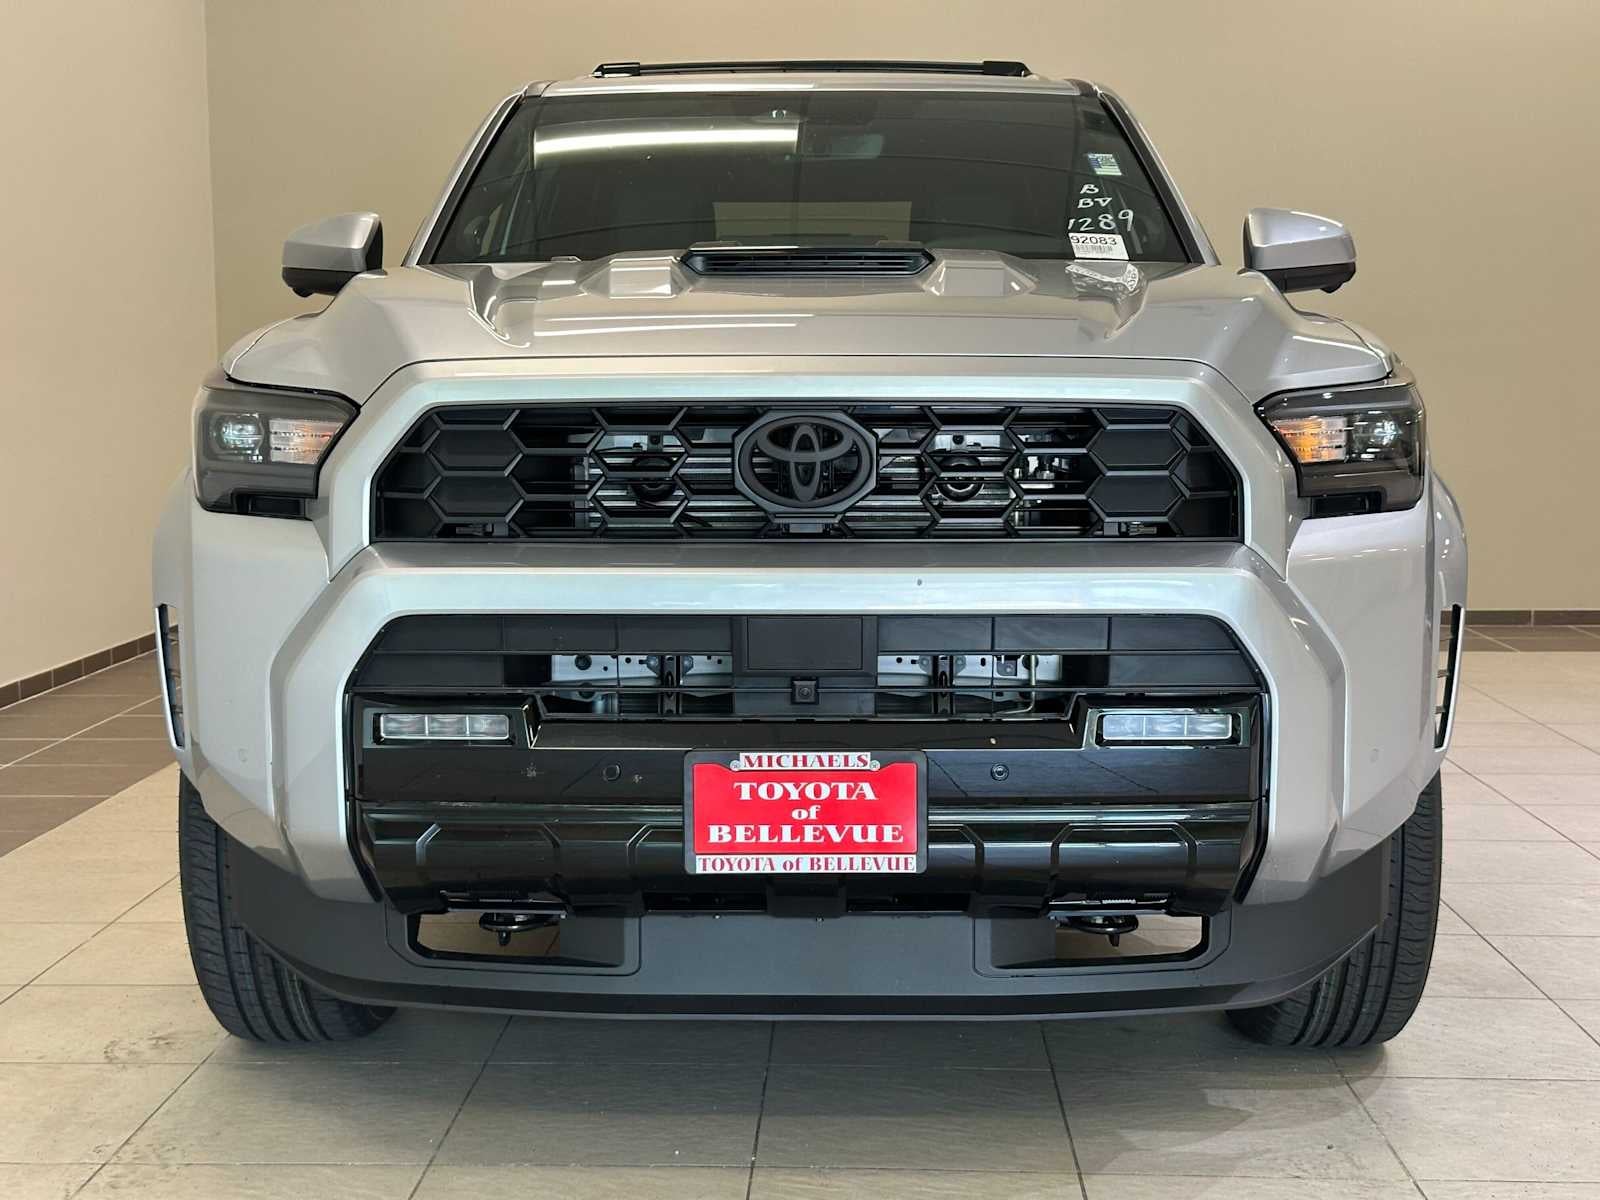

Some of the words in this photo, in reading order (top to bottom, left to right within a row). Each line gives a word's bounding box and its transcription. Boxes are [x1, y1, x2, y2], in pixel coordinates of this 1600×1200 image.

[1067, 209, 1134, 232] 1289
[1070, 235, 1117, 246] 92083
[742, 753, 870, 769] MICHAELS
[733, 781, 878, 801] TOYOTA
[791, 805, 821, 820] of
[707, 824, 904, 844] BELLEVUE
[698, 857, 775, 872] TOYOTA
[782, 856, 802, 871] of
[809, 856, 915, 872] BELLEVUE
